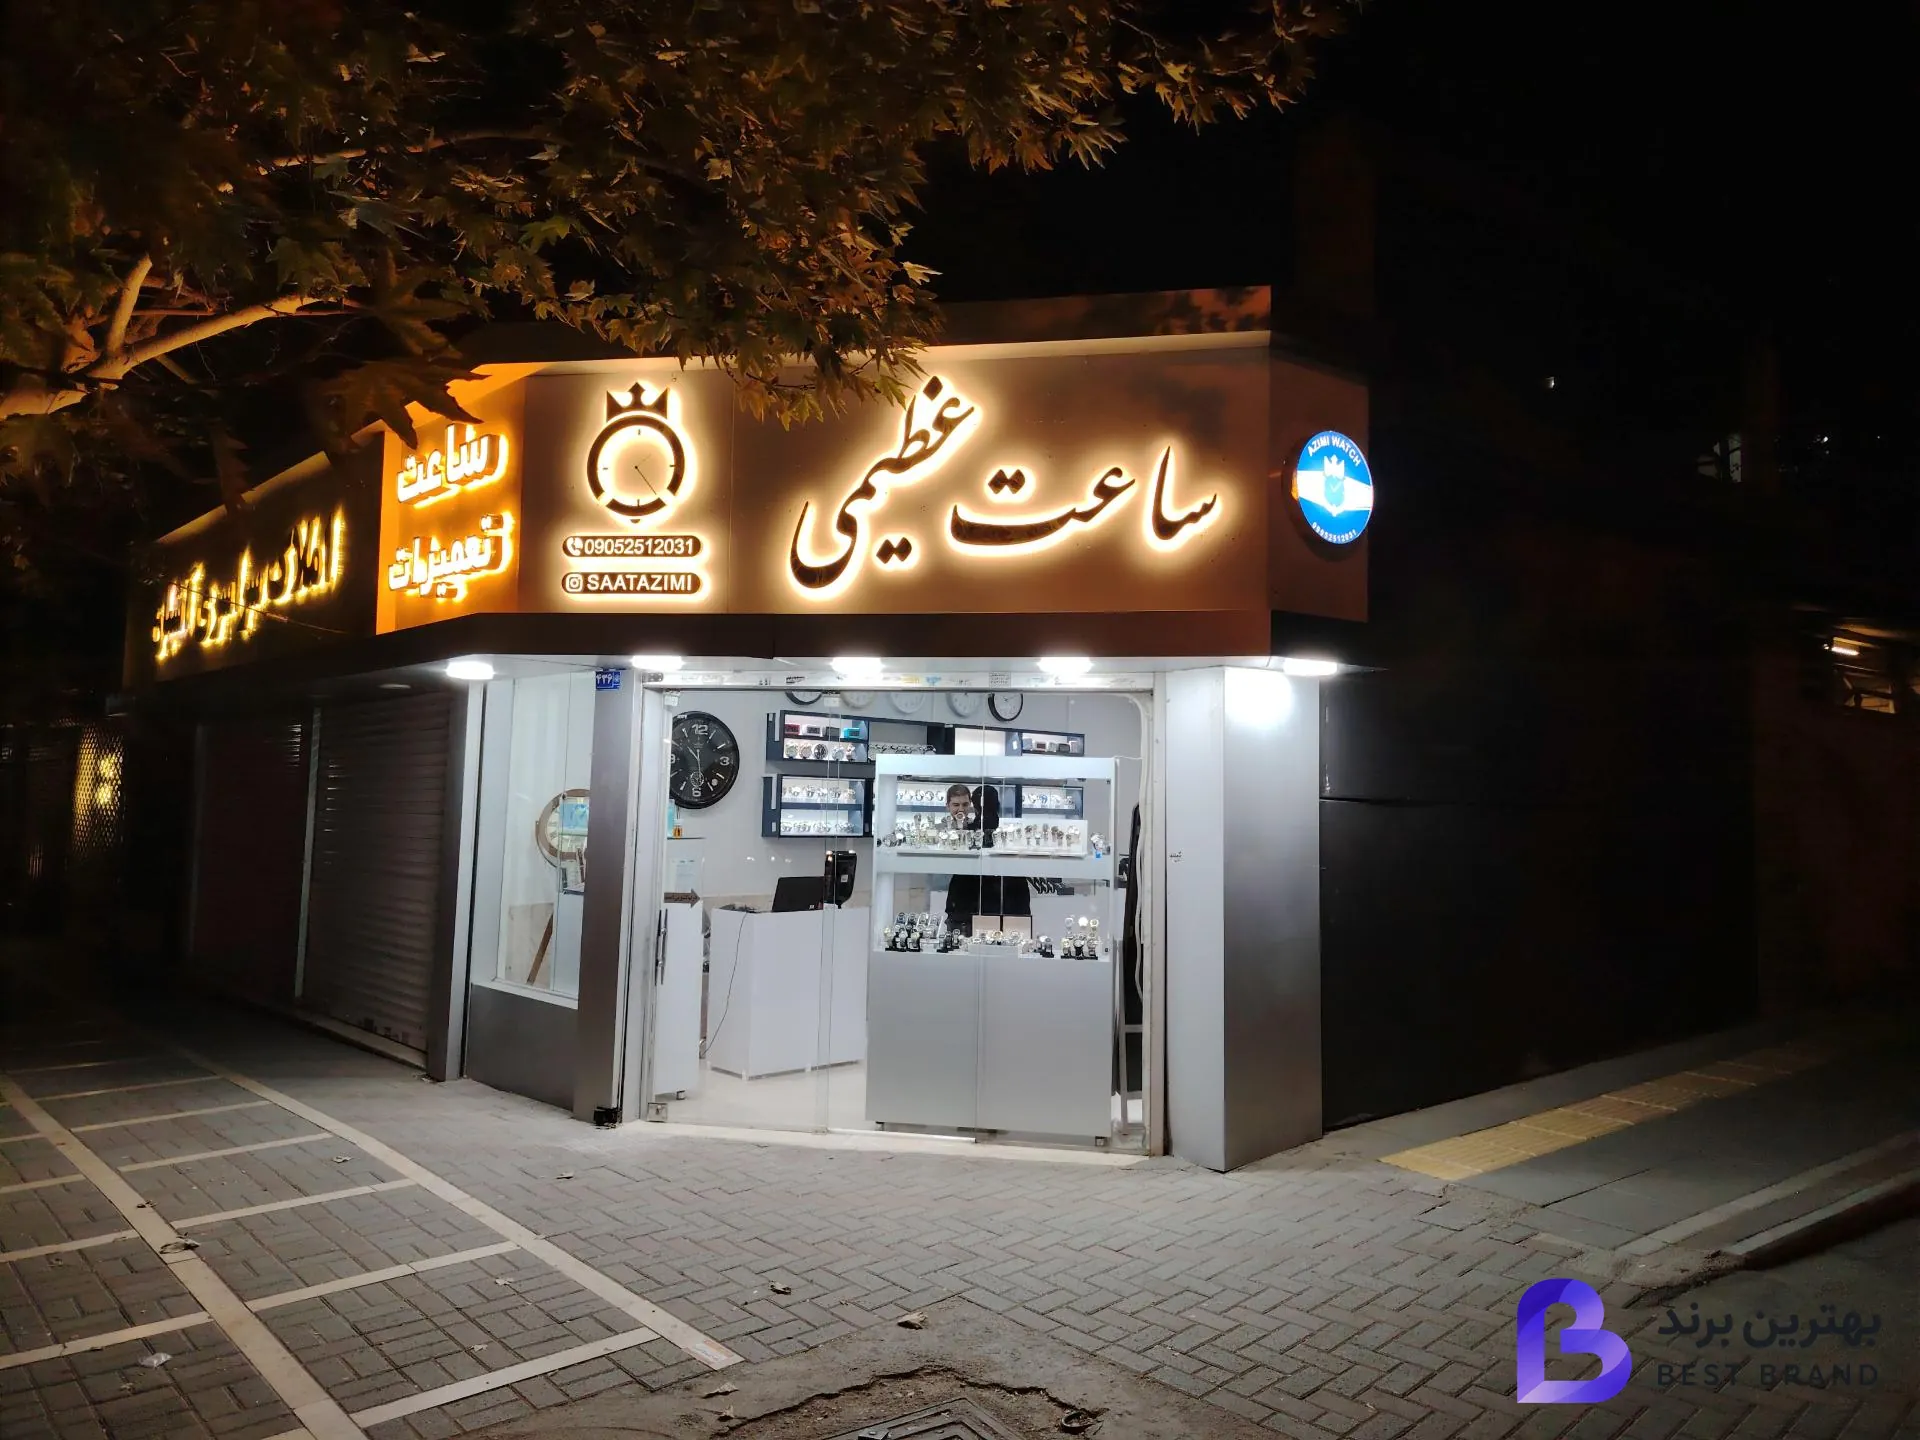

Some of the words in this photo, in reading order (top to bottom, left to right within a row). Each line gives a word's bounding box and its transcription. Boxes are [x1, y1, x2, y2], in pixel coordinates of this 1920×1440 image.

[397, 423, 503, 505] ساعت
[1308, 436, 1330, 456] AZIMI
[1332, 435, 1361, 466] WATCH
[789, 374, 976, 589] عظیمی
[948, 445, 1219, 546] ساعت
[388, 513, 507, 599] تعمیرات
[584, 538, 693, 555] 09052512031
[587, 574, 691, 591] SAATAZIMI
[692, 723, 709, 735] 12
[720, 756, 730, 766] 3
